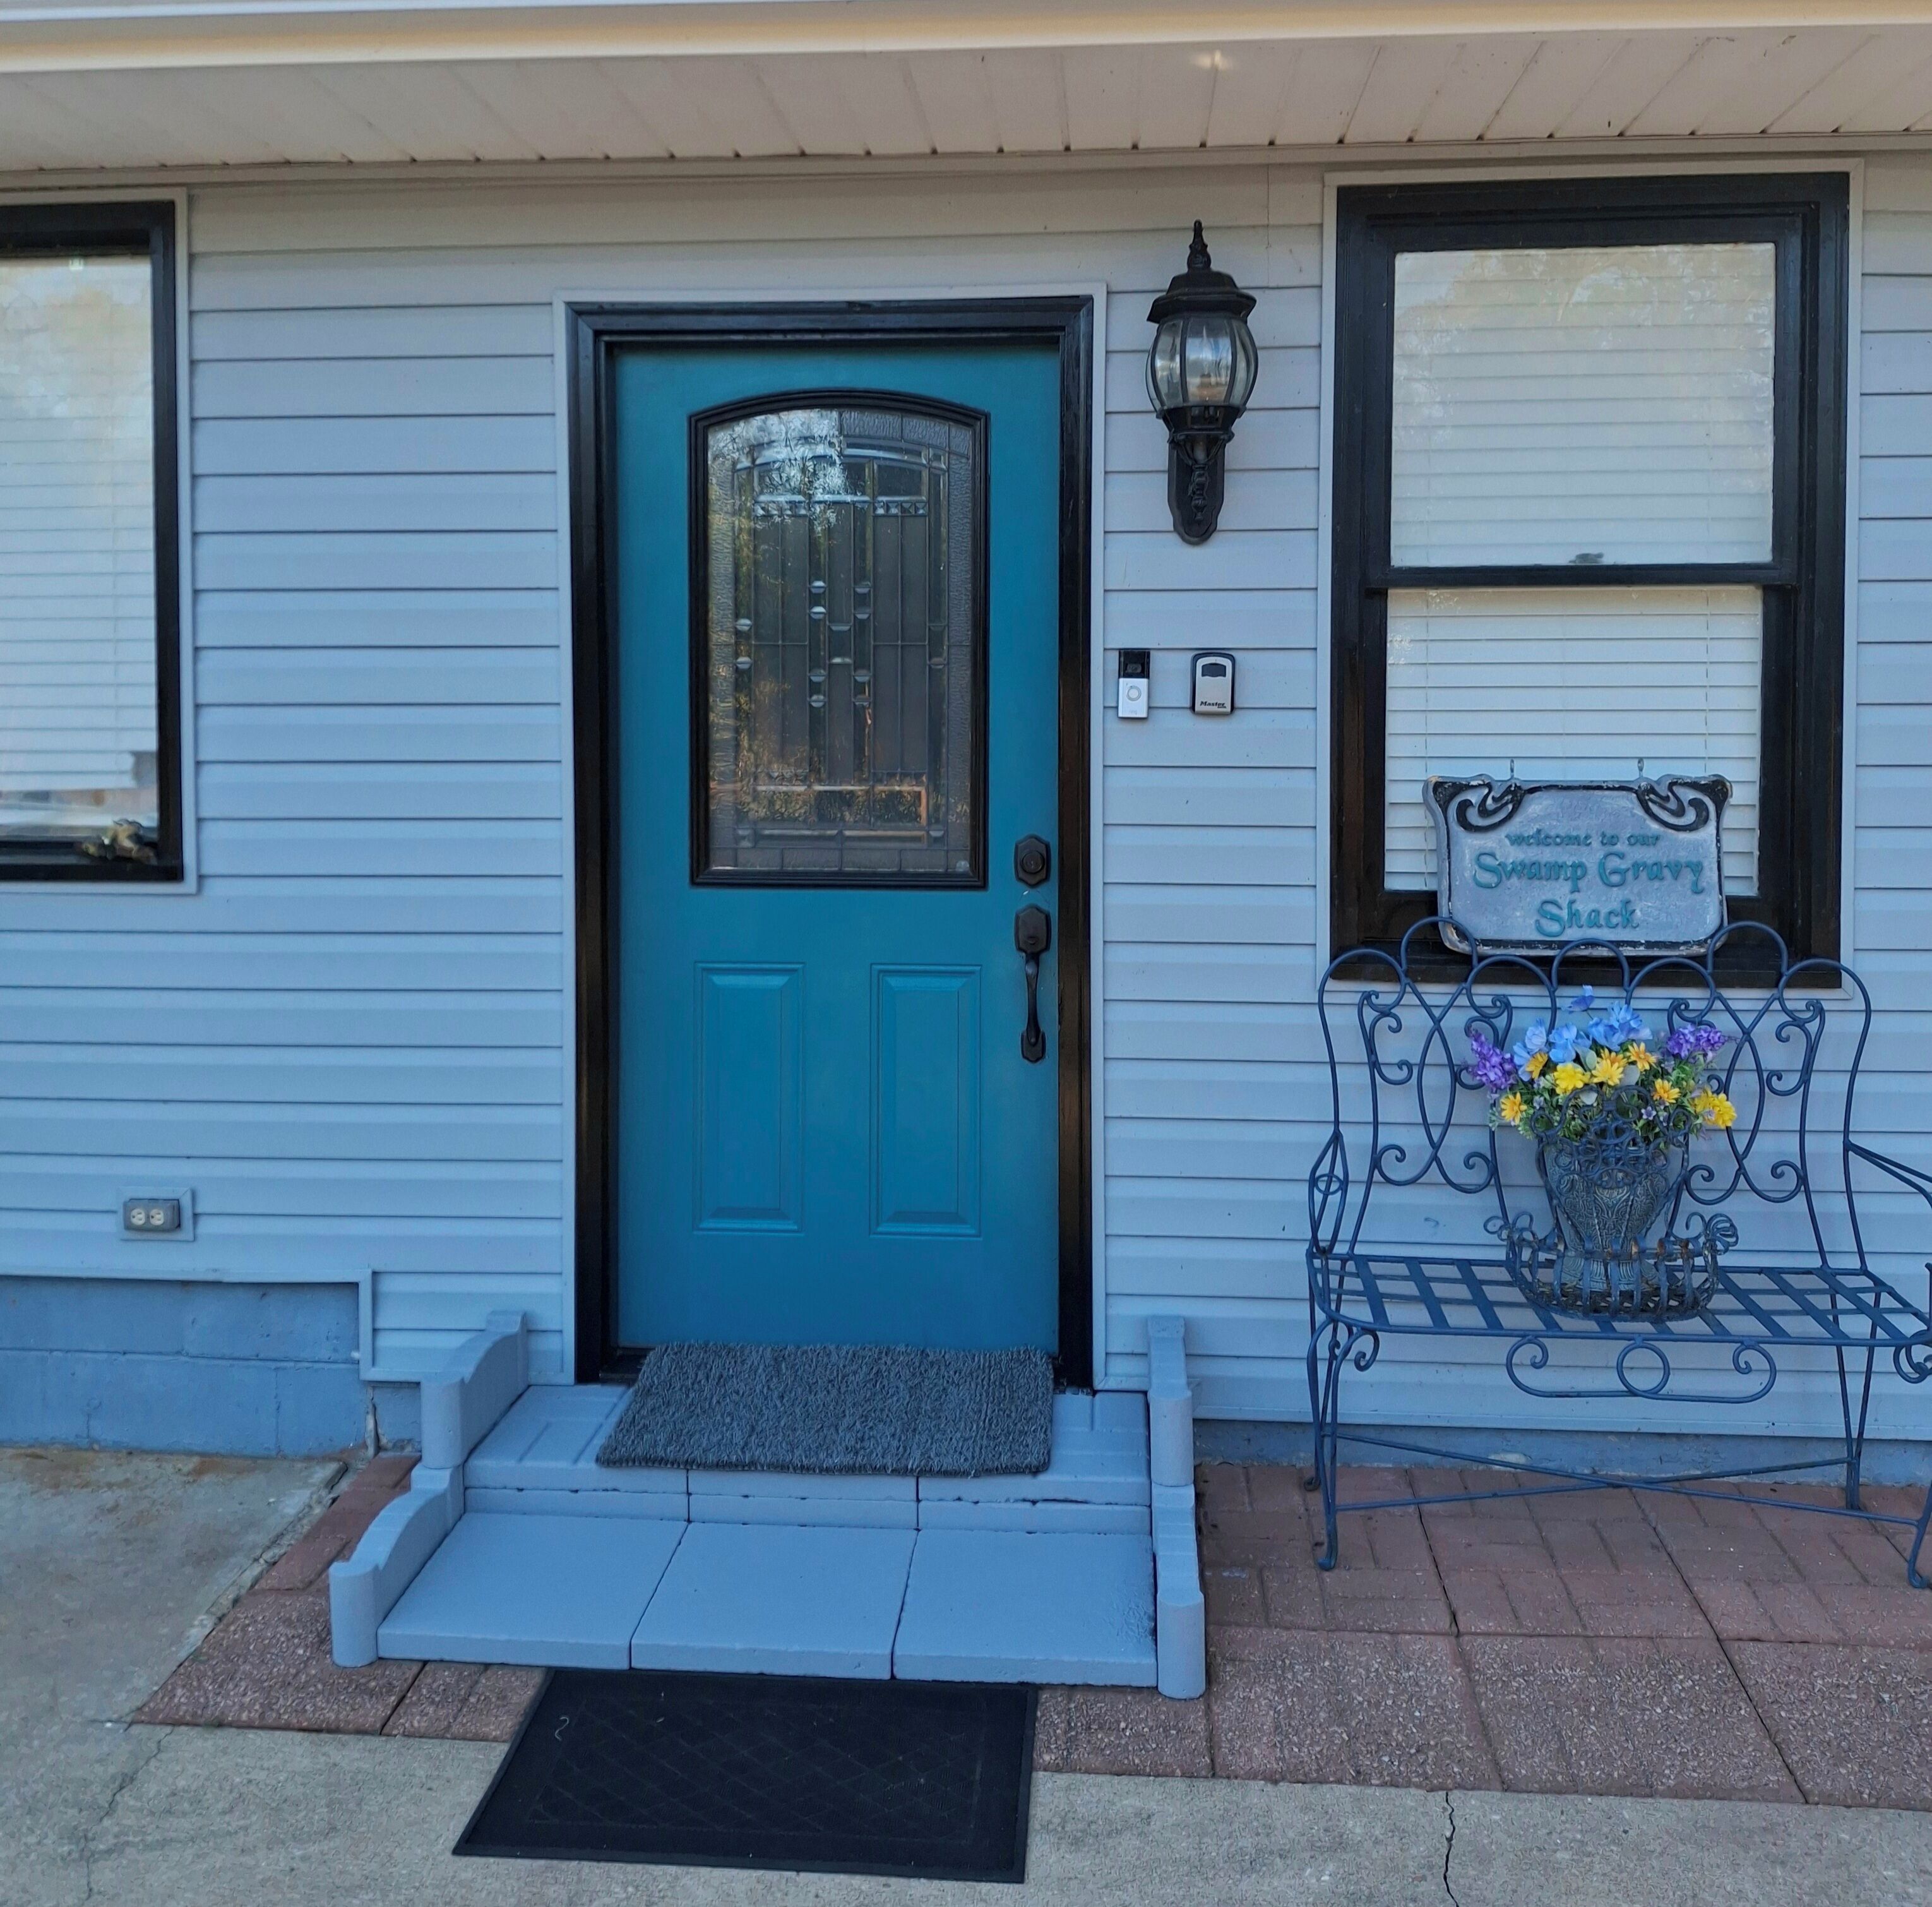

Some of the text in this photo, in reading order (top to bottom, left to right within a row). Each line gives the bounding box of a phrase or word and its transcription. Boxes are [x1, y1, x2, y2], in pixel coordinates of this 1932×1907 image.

[1505, 828, 1661, 847] welcome to our
[1472, 851, 1705, 894] Swamp Gravy
[1535, 898, 1641, 938] Shack
